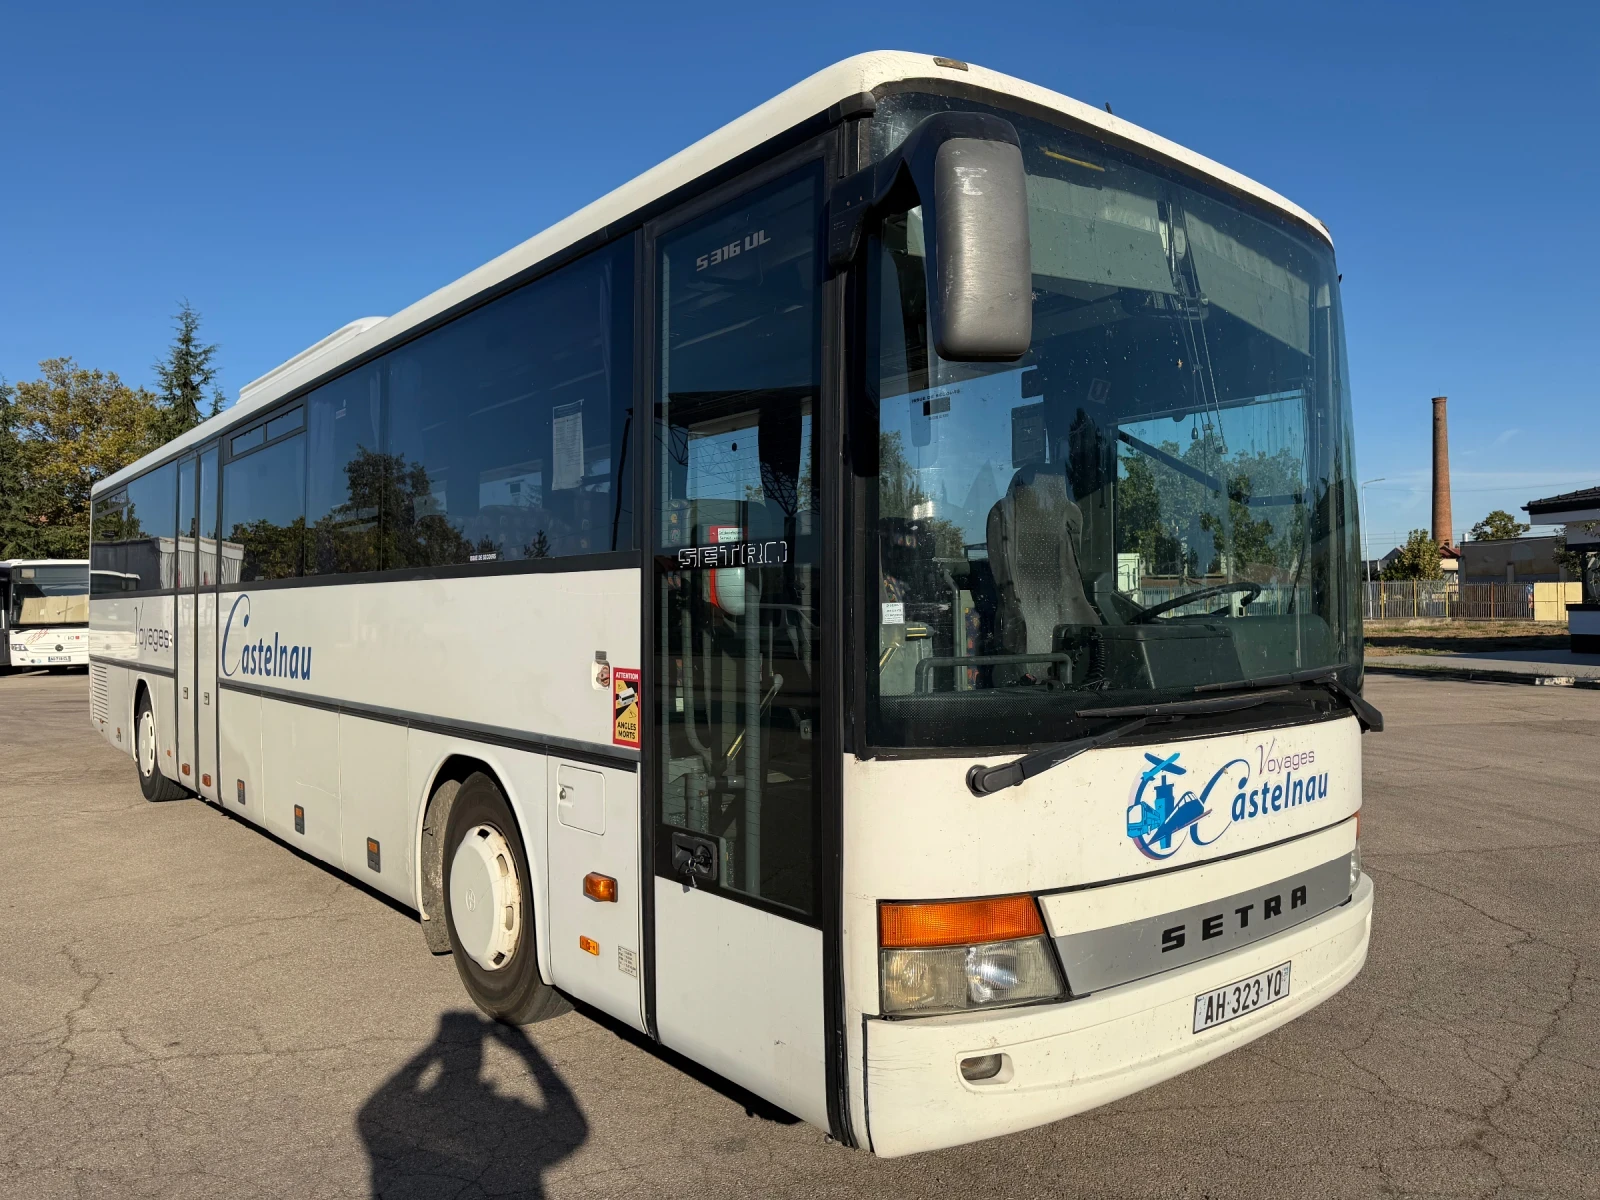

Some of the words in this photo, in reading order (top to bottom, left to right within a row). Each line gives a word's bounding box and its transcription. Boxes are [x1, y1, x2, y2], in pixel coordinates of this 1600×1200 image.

[711, 240, 741, 265] 316
[745, 230, 771, 251] UL
[134, 599, 169, 652] Voyages
[222, 594, 311, 680] Castelnau
[615, 671, 639, 680] ATTENTION
[617, 721, 637, 731] ANGLES
[618, 730, 636, 740] MORTS
[1255, 736, 1315, 775] Voyages
[1190, 759, 1328, 845] Castelnau
[1162, 885, 1306, 953] SETRA
